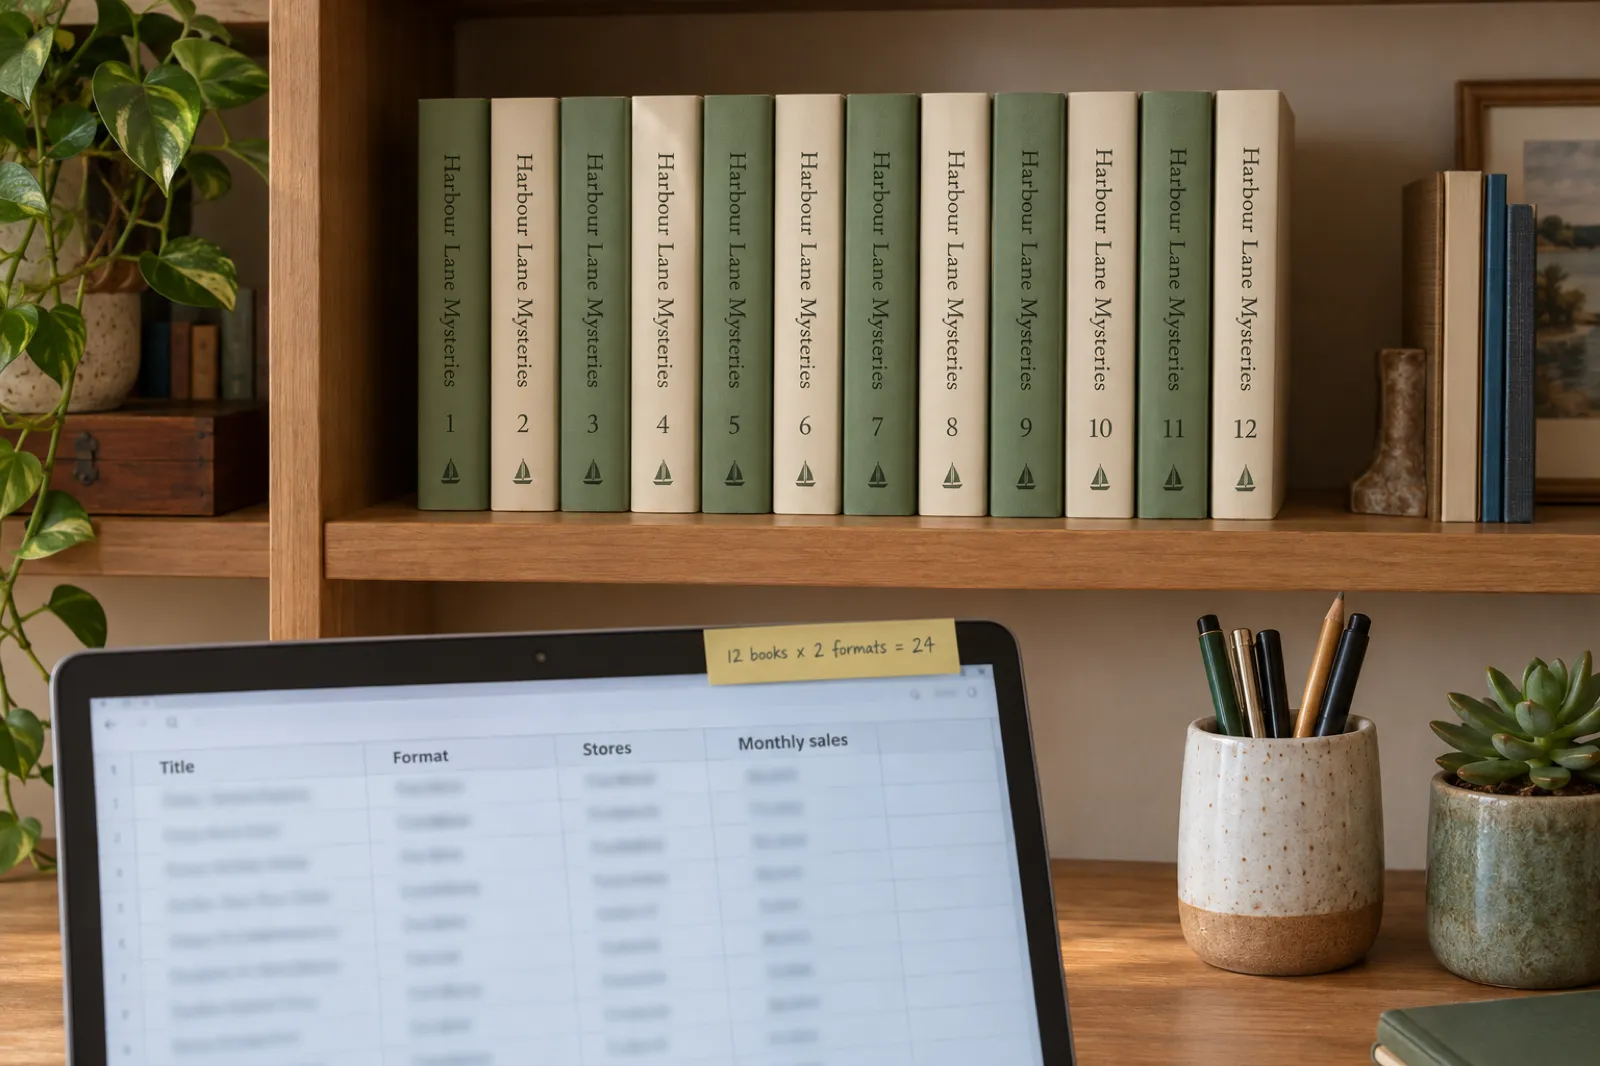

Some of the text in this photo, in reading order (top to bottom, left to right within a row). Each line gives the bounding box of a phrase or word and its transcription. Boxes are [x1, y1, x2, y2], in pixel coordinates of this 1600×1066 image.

[439, 154, 461, 388] Harbour Lane Mysteries
[511, 153, 534, 388] Harbour Lane Mysteries
[581, 153, 604, 388] Harbour Lane Mysteries
[652, 152, 675, 388] Harbour Lane Mysteries
[724, 152, 747, 389] Harbour Lane Mysteries
[795, 151, 819, 389] Harbour Lane Mysteries
[867, 151, 891, 390] Harbour Lane Mysteries
[941, 150, 966, 390] Harbour Lane Mysteries
[1015, 150, 1039, 391] Harbour Lane Mysteries
[1089, 148, 1113, 391] Harbour Lane Mysteries
[1163, 148, 1188, 392] Harbour Lane Mysteries
[1235, 147, 1260, 392] Harbour Lane Mysteries
[446, 413, 455, 433] 1
[516, 413, 529, 433] 2
[587, 413, 599, 434] 3
[656, 414, 670, 434] 4
[728, 414, 741, 435] 5
[799, 415, 812, 436] 6
[871, 416, 884, 437] 7
[946, 416, 958, 437] 8
[1020, 417, 1033, 438] 9
[1089, 418, 1113, 438] 10
[1163, 418, 1185, 439] 11
[1234, 418, 1257, 439] 12
[727, 648, 744, 664] 12
[749, 645, 789, 662] books
[813, 642, 825, 659] 2
[831, 639, 888, 659] formats
[911, 635, 936, 654] 24
[582, 742, 632, 757] Stores
[737, 732, 849, 752] Monthly sales
[159, 759, 195, 775] Title
[393, 750, 449, 765] Format
